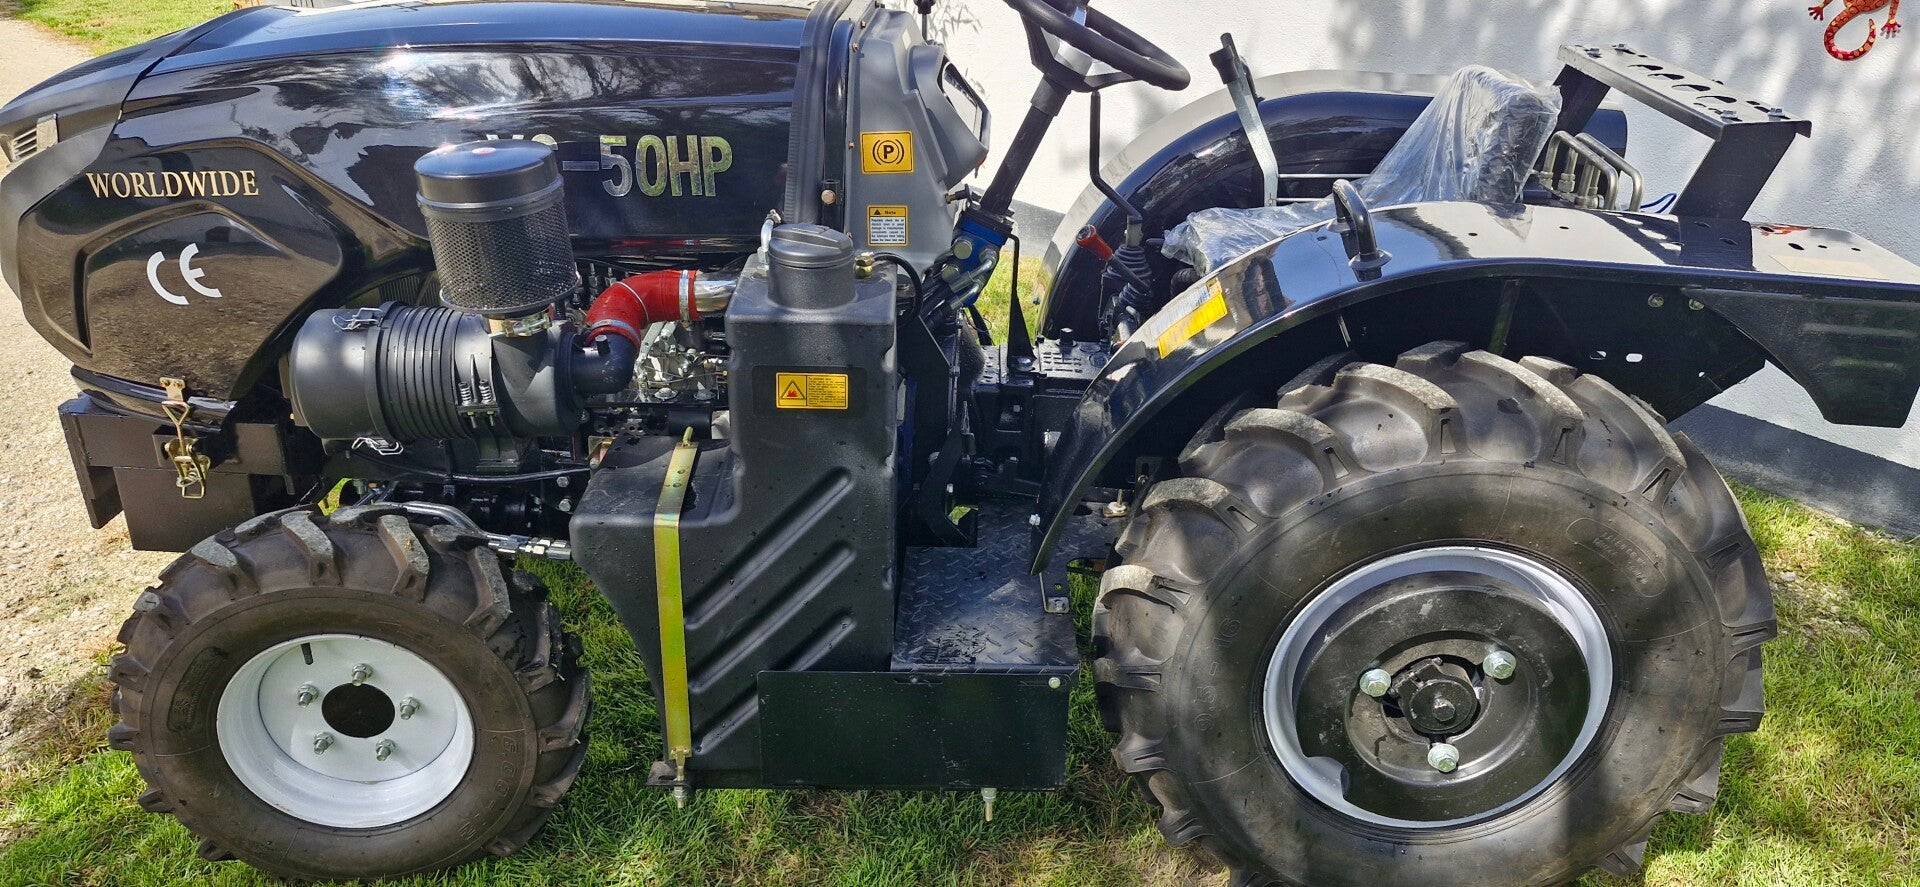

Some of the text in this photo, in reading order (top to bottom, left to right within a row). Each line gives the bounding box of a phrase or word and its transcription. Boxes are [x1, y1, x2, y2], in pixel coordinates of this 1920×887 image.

[486, 134, 733, 197] -50HP
[883, 144, 895, 160] P
[86, 170, 259, 198] WORLDWIDE
[146, 242, 223, 306] CE
